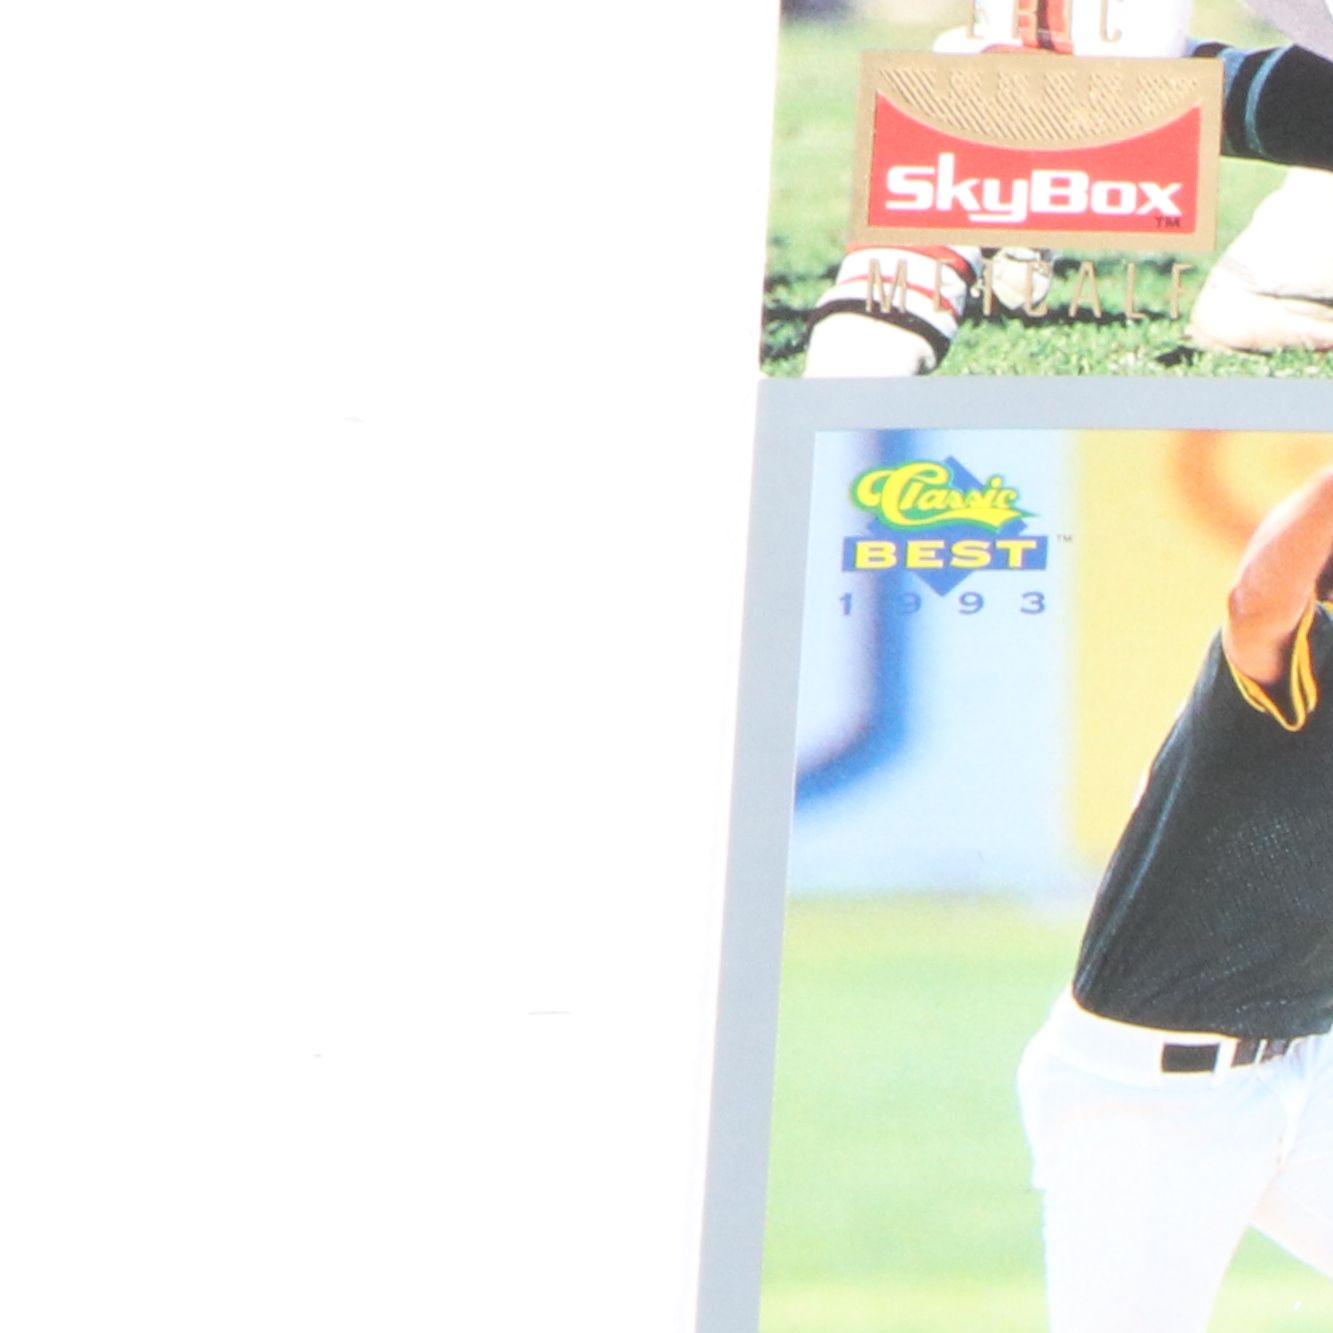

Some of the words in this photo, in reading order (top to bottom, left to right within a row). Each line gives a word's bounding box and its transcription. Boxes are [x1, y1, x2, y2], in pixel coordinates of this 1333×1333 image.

[886, 152, 1182, 224] SkyBox
[855, 461, 1020, 528] Classic
[854, 539, 1037, 568] BEST
[840, 591, 1046, 616] 1993
